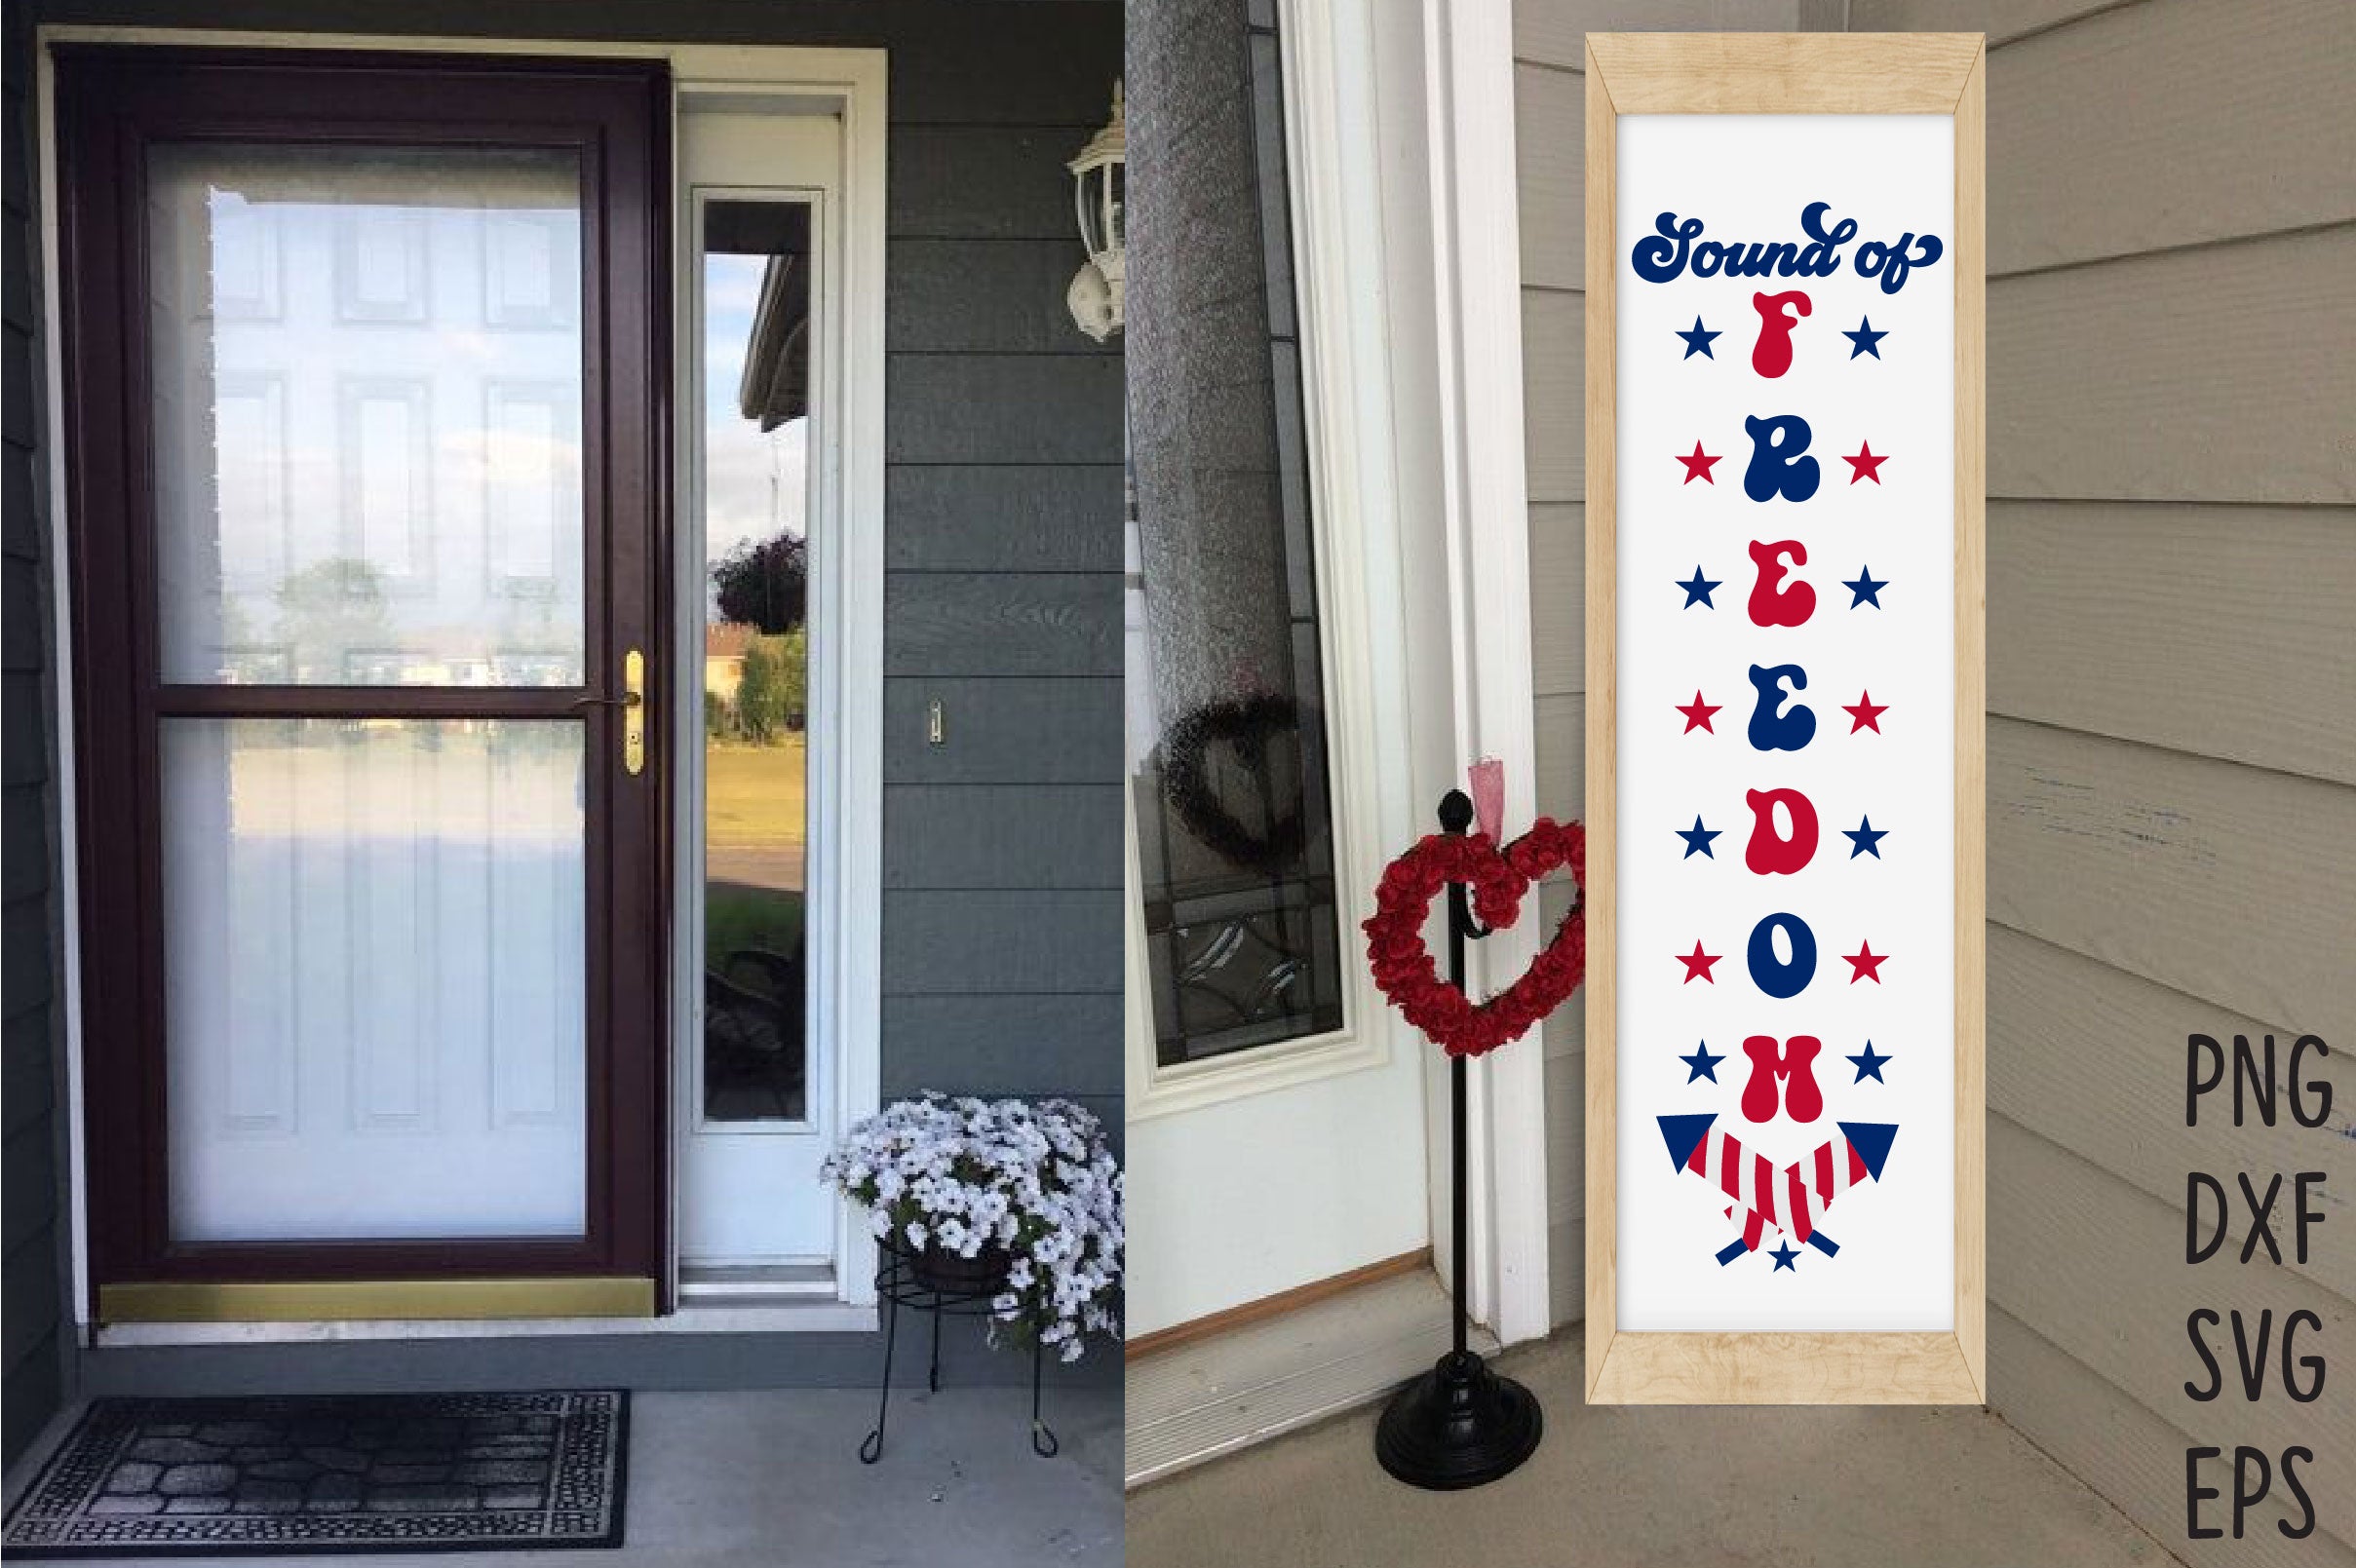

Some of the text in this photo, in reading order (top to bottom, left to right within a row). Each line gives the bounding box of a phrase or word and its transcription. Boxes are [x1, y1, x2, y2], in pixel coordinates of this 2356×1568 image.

[1631, 201, 1944, 295] Sound of
[1740, 289, 1824, 1124] FREEDOM
